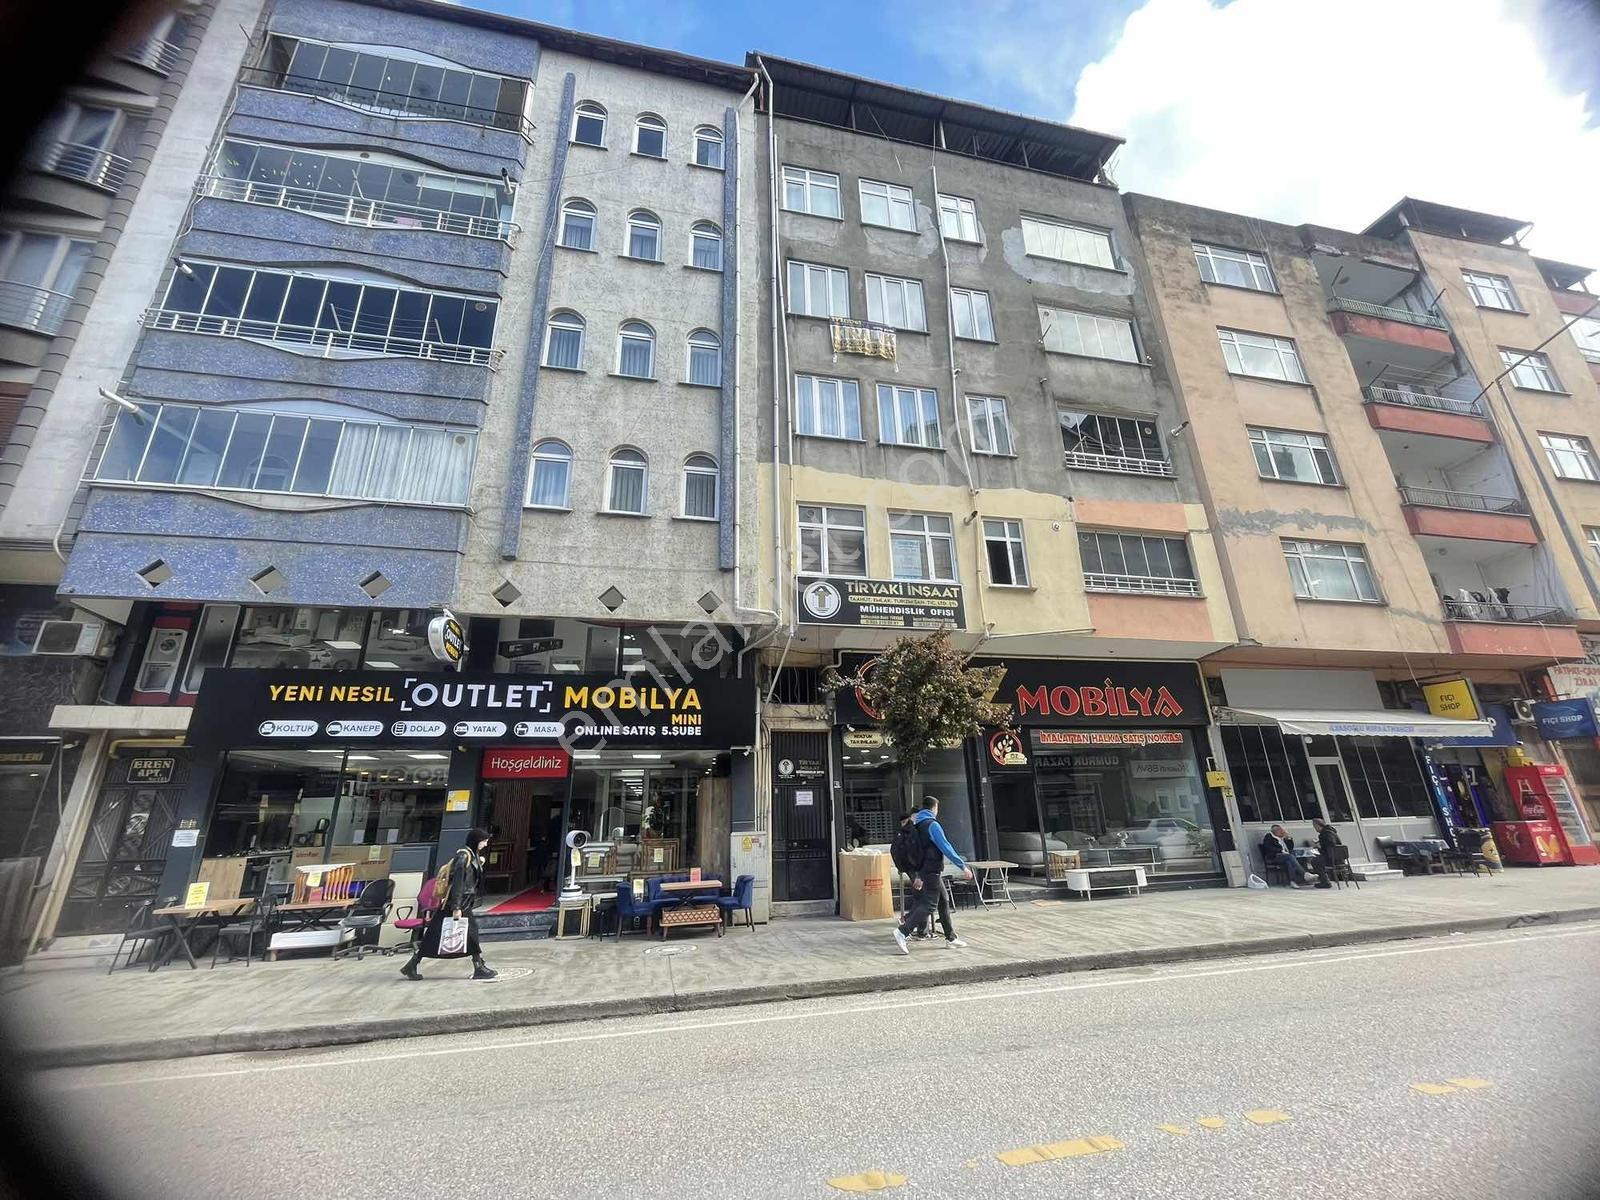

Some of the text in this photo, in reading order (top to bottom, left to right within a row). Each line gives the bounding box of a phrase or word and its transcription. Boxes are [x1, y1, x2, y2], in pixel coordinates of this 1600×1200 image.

[907, 582, 960, 599] İNŞAAT
[411, 682, 545, 708] OUTLET
[1016, 677, 1184, 718] MOBİLYA
[1439, 702, 1461, 712] SHOP
[1560, 714, 1584, 724] SHOP
[275, 724, 315, 733] KOLTUK
[343, 724, 381, 733] KANEPE
[409, 724, 441, 733] DOLAP
[471, 724, 498, 734] YATAK
[533, 725, 558, 734] MASA
[574, 725, 620, 737] ONLINE
[1091, 732, 1121, 744] HALKA
[133, 760, 172, 769] EREN
[491, 756, 562, 773] Hoşgeldiniz
